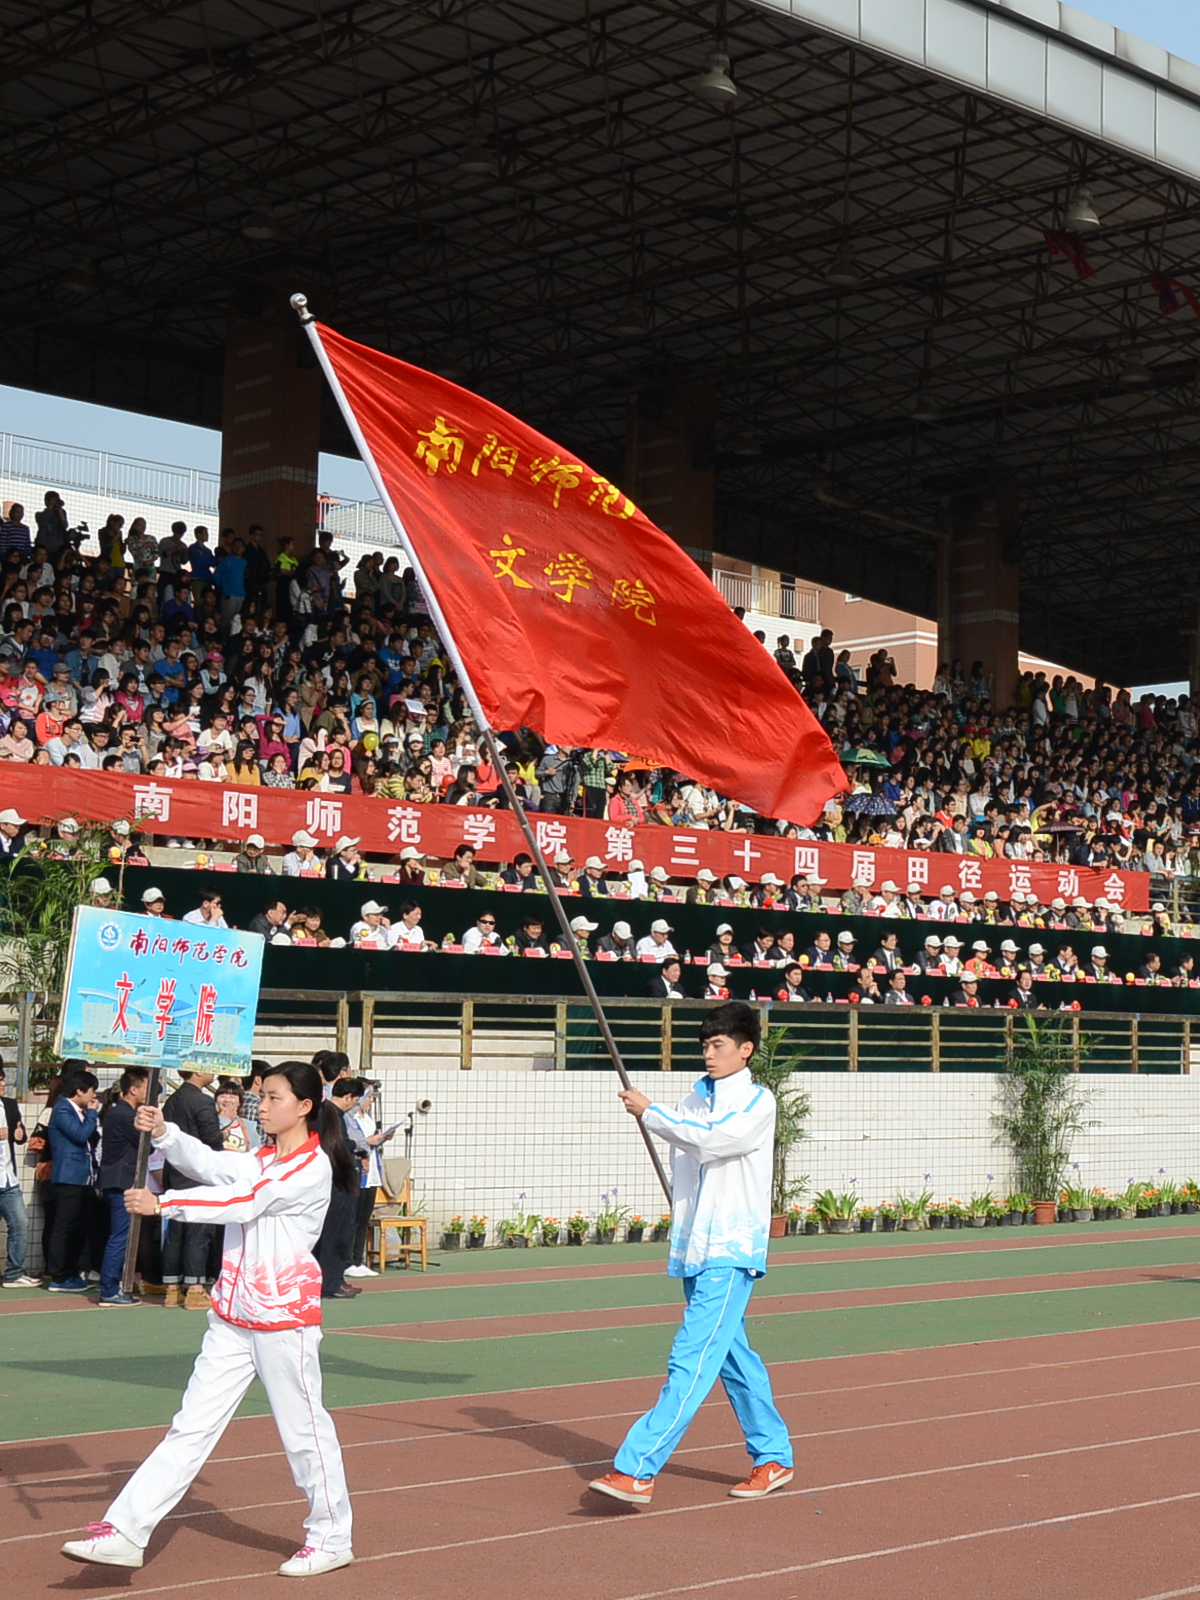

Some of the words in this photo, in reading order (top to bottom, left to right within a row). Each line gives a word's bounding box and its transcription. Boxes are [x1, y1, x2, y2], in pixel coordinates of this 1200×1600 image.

[490, 534, 657, 626] 文学院
[133, 781, 1126, 902] 南阳师范学院第三十四届田径运动会
[129, 928, 249, 968] 南阳师范学院
[110, 972, 218, 1045] 文学院
